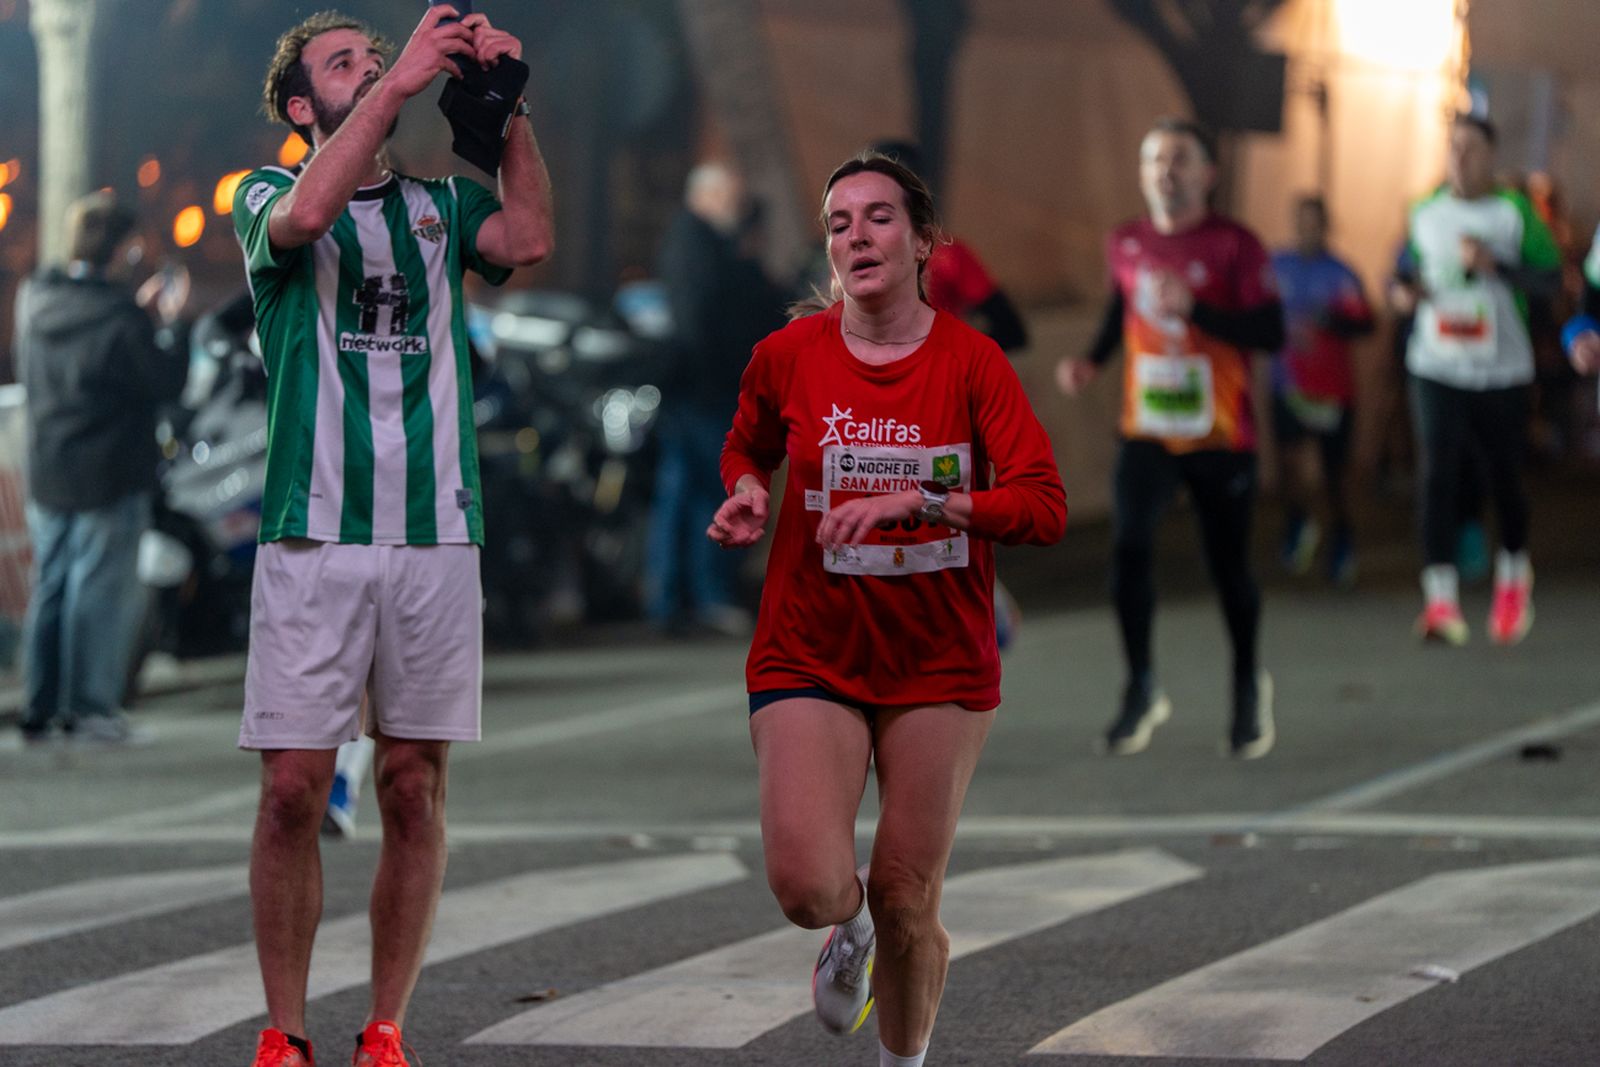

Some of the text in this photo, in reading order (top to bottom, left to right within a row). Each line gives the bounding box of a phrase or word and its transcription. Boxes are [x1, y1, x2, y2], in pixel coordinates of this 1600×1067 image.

[341, 334, 424, 352] network
[843, 417, 921, 443] califas
[857, 462, 920, 476] NOCHE DE
[840, 476, 869, 490] SAN
[872, 475, 920, 491] ANTÓN
